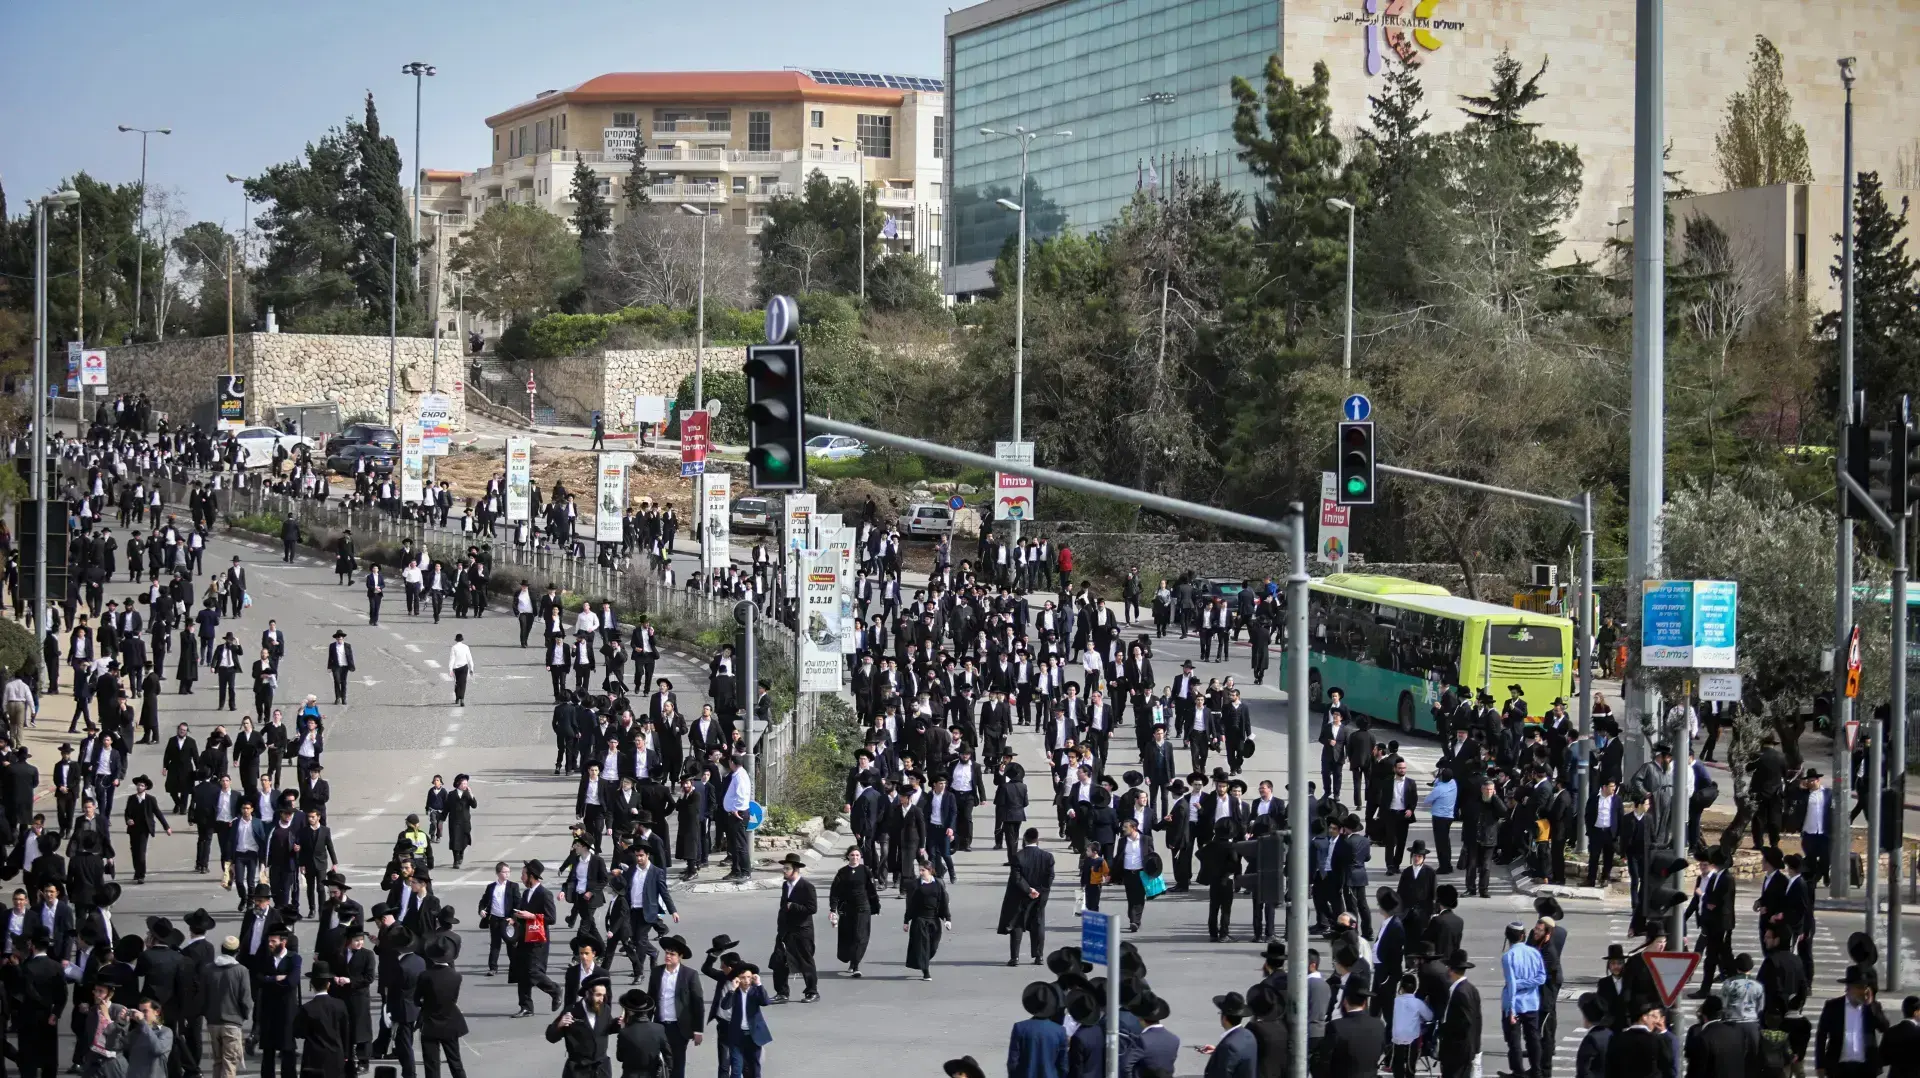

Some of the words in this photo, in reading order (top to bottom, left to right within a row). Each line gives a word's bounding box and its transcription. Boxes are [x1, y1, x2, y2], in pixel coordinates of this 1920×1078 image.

[1333, 12, 1354, 22] القدس
[1381, 16, 1430, 28] JERUSALEM
[1433, 19, 1465, 31] ירושלים
[604, 130, 637, 139] ופלקסים
[1324, 514, 1345, 524] שמח!
[813, 566, 833, 574] מרתון
[808, 582, 835, 591] ירושלים
[809, 596, 833, 604] 9.3.18
